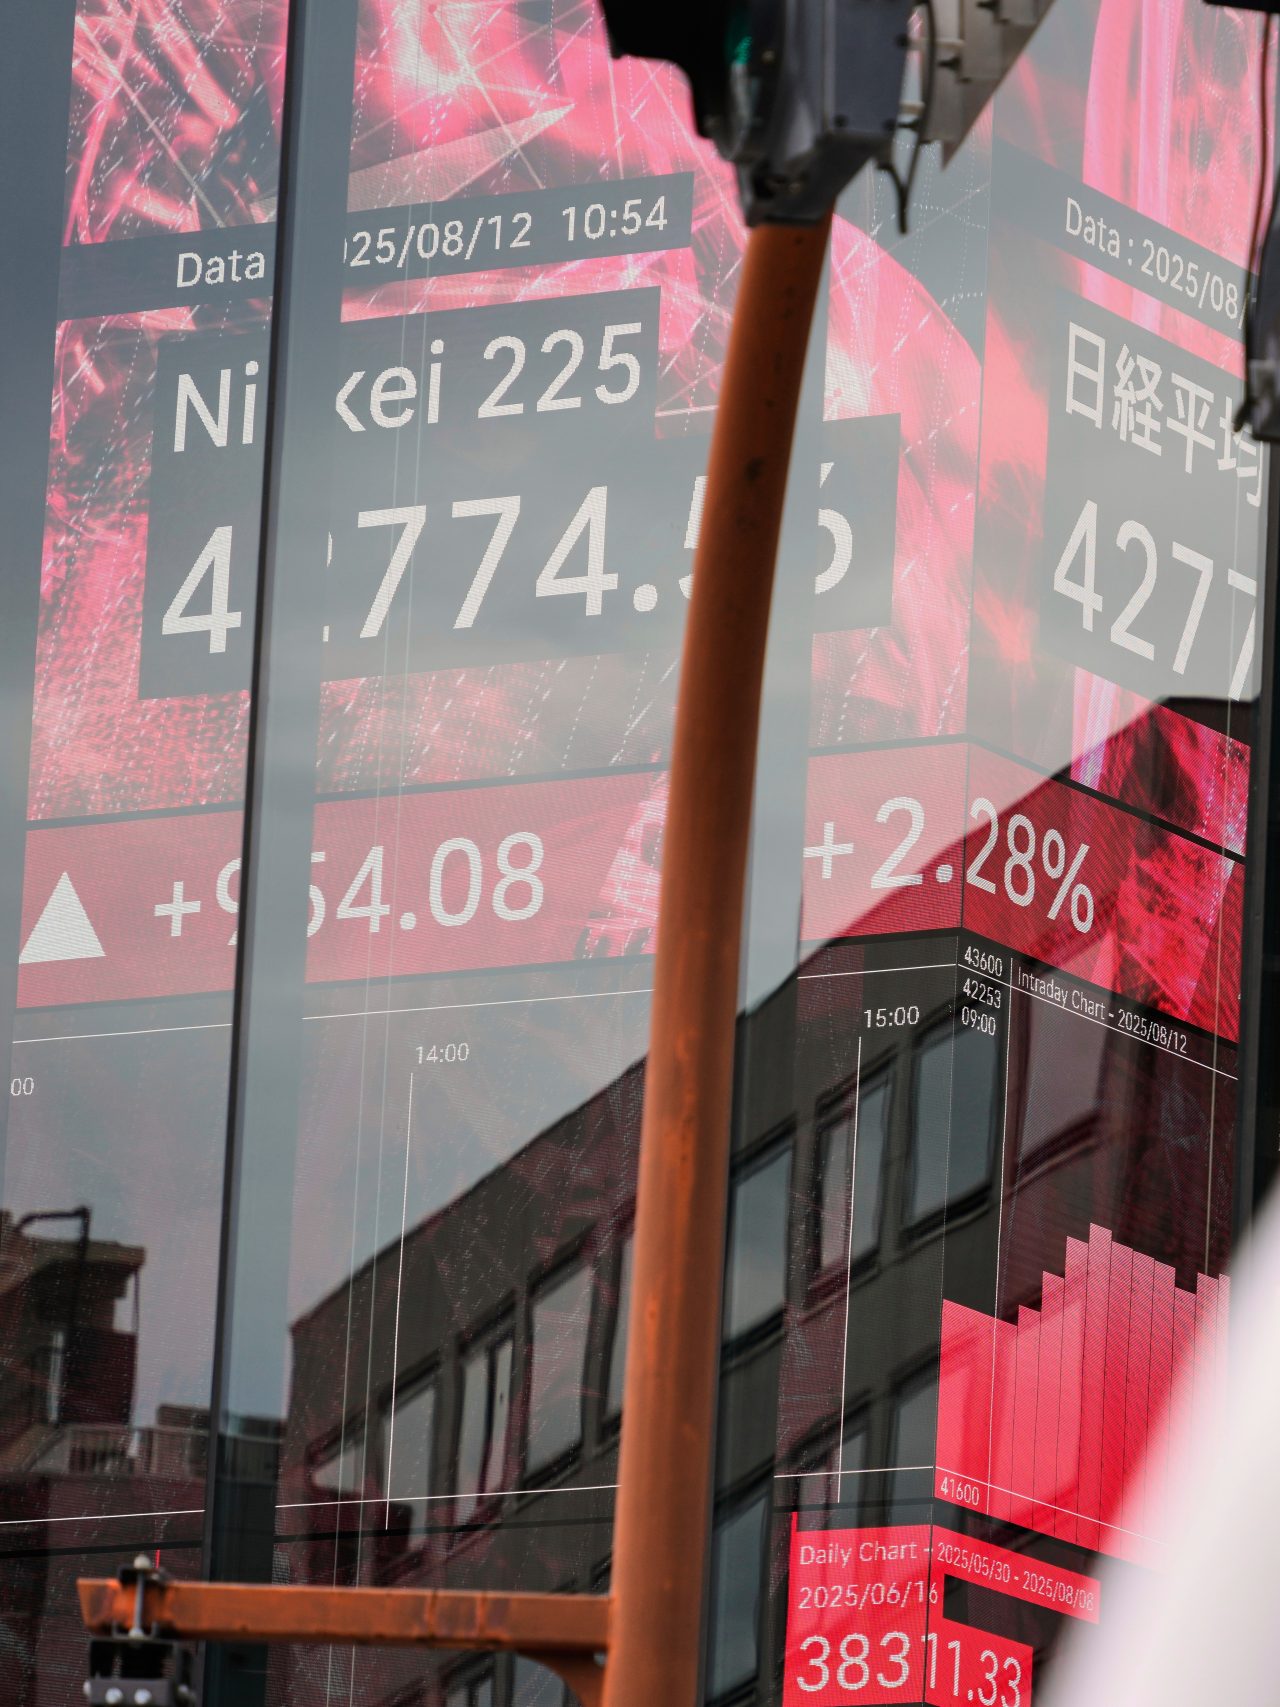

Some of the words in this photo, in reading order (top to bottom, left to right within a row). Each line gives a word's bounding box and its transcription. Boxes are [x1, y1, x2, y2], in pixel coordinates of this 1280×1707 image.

[176, 250, 265, 288] Data
[343, 212, 533, 267] 25/08/12
[561, 196, 668, 241] 10:54
[1140, 239, 1248, 330] 2025/08/
[478, 322, 642, 419] 225
[161, 462, 853, 655] 4774.
[964, 946, 1003, 978] 43600
[962, 978, 1002, 1009] 42253
[1018, 966, 1068, 1009] Intraday
[1071, 990, 1106, 1020] Chart
[1117, 1009, 1188, 1054] 2025/08/12
[863, 1005, 920, 1028] 15:00
[961, 1006, 997, 1036] 09:00
[415, 1042, 470, 1065] 14:00
[940, 1476, 980, 1506] 41600
[800, 1544, 852, 1567] Daily
[859, 1540, 917, 1563] Chart
[937, 1541, 1010, 1583] 2025/05/30
[799, 1580, 939, 1611] 2025/06/16
[796, 1630, 1022, 1707] 38311.33
